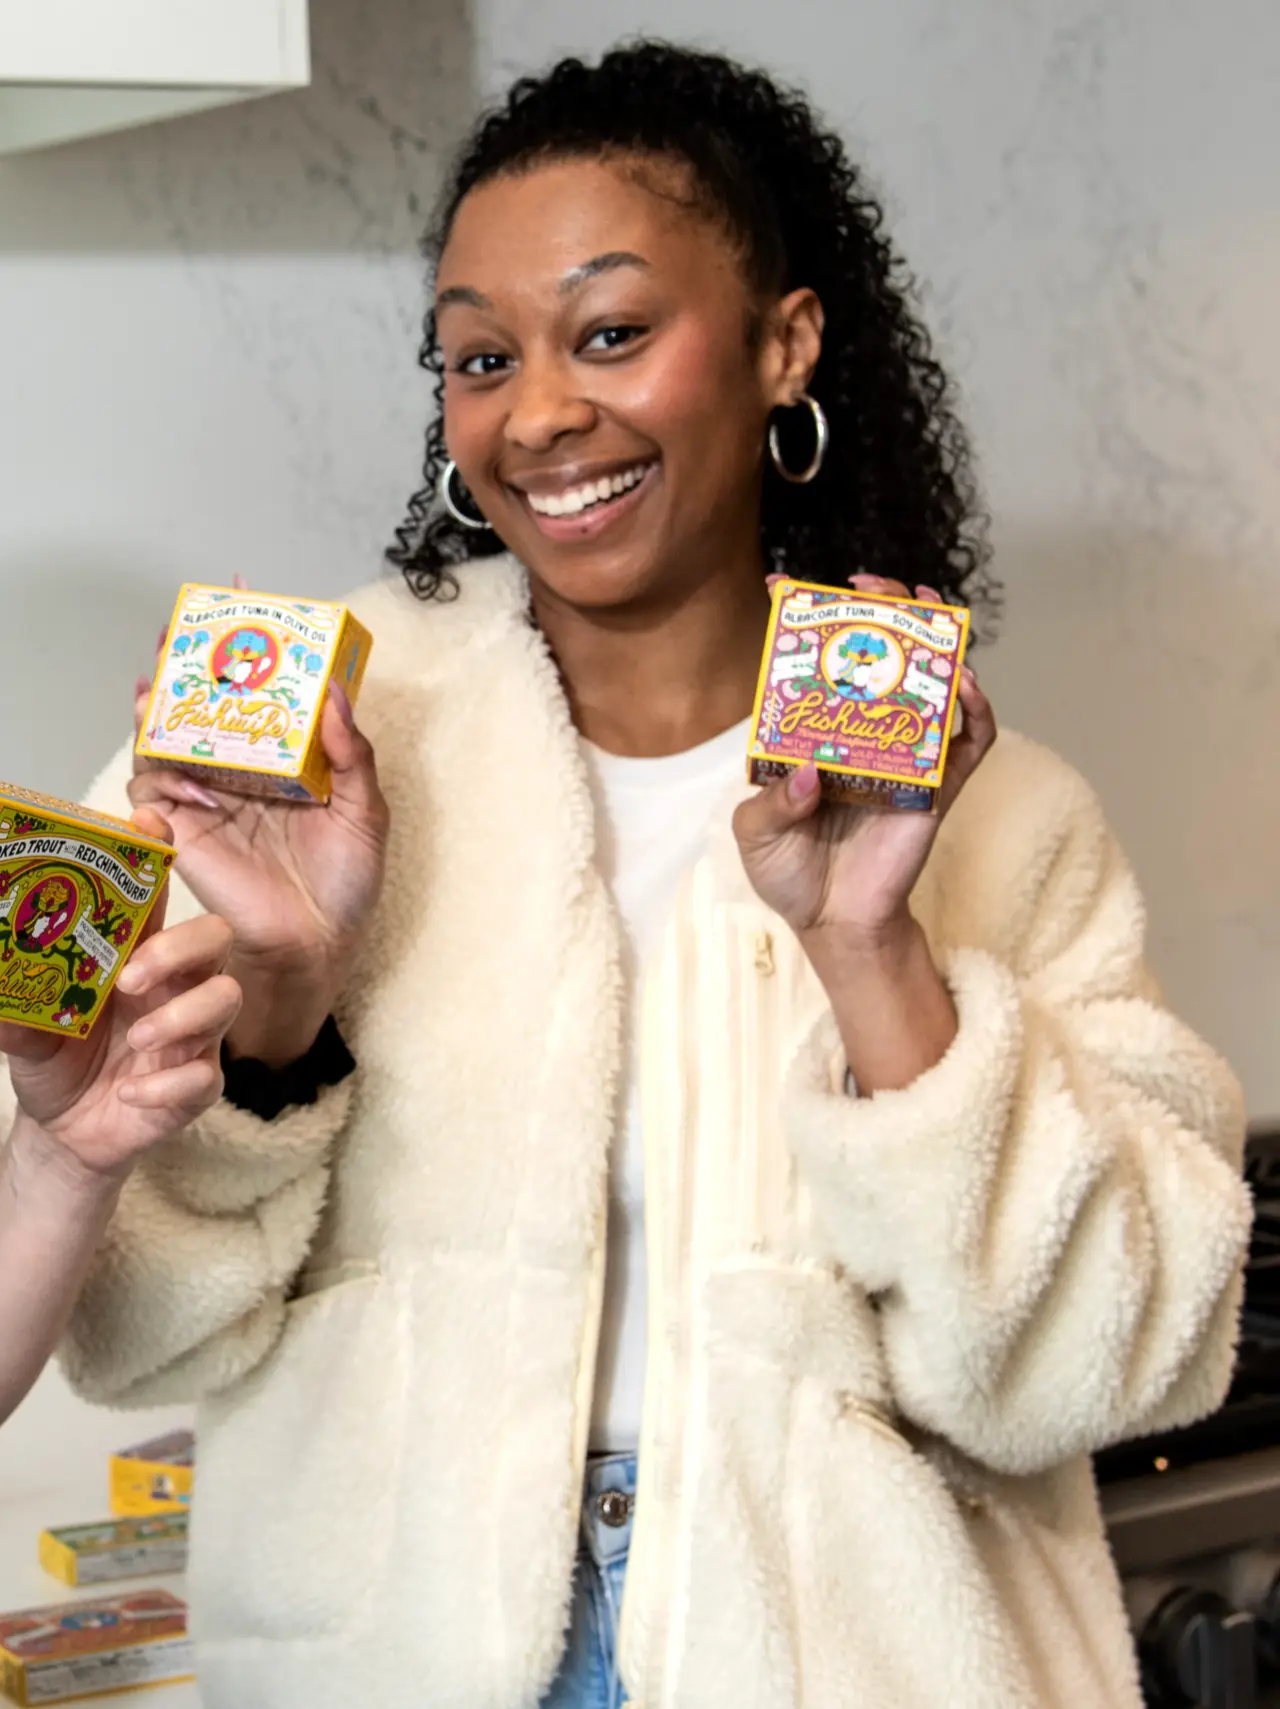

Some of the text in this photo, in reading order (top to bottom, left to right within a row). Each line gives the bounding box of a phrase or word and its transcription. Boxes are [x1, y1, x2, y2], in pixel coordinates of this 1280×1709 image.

[183, 605, 326, 642] ALBACORE TUNA IN OLIVE OIL
[784, 606, 954, 647] ALBACORE TUNA SOY GINGER
[166, 689, 290, 744] Fishwife
[779, 691, 923, 750] Fishwife
[27, 839, 66, 854] TROUT
[74, 844, 97, 863] RED
[95, 854, 150, 900] CHIMICHURRI
